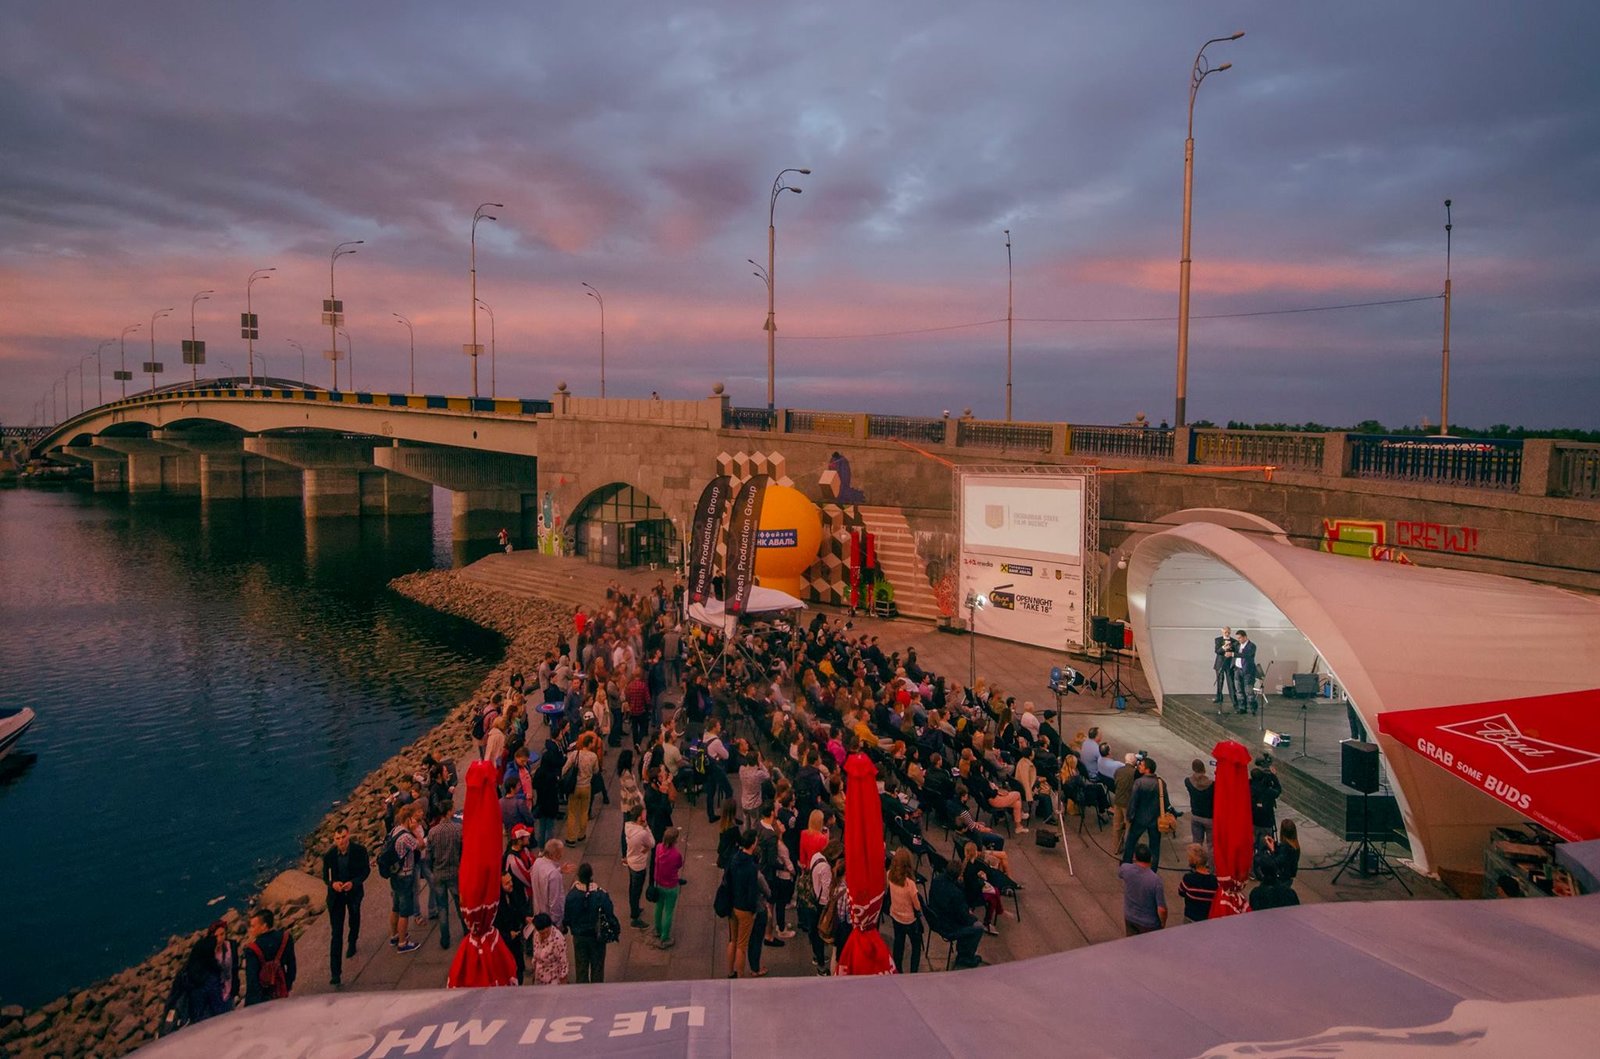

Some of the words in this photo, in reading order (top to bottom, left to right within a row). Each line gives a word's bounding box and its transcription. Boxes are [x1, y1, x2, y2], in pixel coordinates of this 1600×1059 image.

[708, 487, 720, 515] Group
[744, 485, 757, 516] Group
[701, 517, 713, 566] Production
[738, 519, 750, 571] Production
[768, 538, 795, 546] АВАЛЬ
[697, 569, 706, 593] Fresh
[735, 574, 745, 601] Fresh
[1016, 594, 1032, 604] OPEN
[1033, 597, 1053, 607] NIGHT
[1476, 721, 1556, 758] Bud
[1416, 737, 1455, 767] GRAB
[1456, 761, 1484, 781] SOME
[1483, 774, 1533, 810] BUDS
[608, 1006, 705, 1038] ЦЕ
